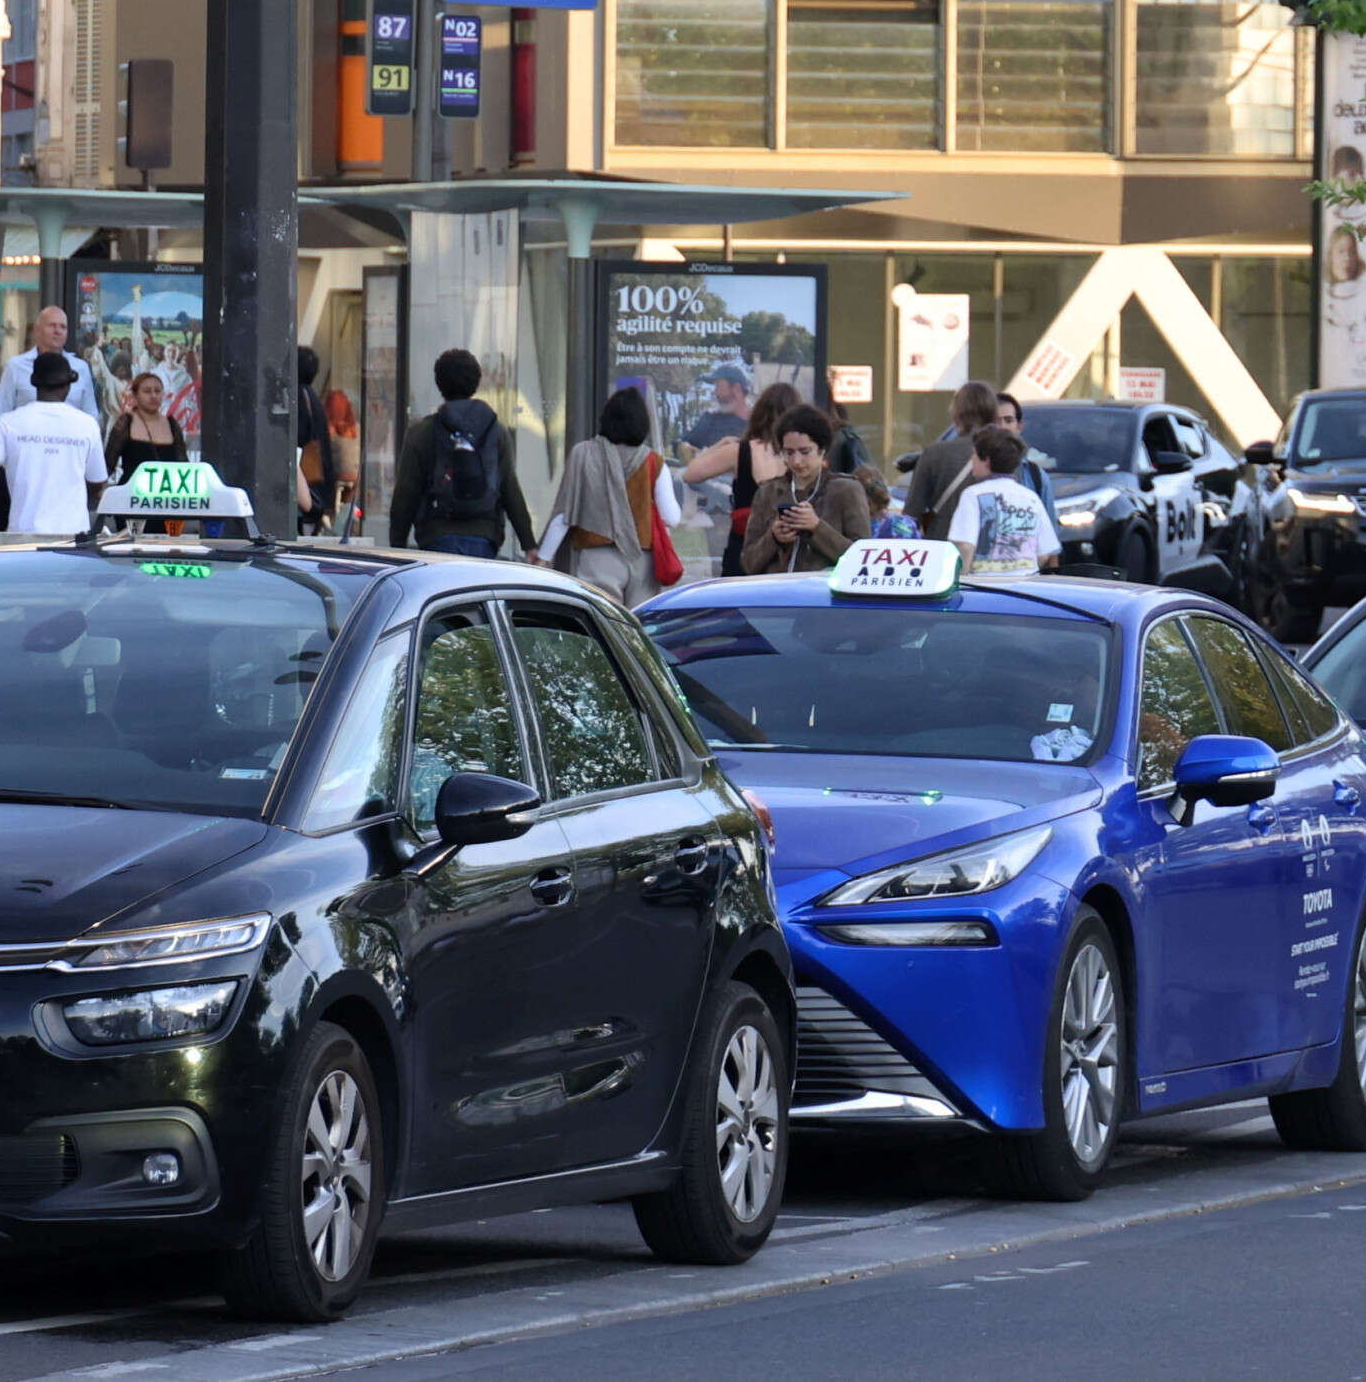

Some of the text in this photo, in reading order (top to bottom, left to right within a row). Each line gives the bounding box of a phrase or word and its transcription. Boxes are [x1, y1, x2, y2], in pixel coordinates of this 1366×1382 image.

[378, 16, 406, 38] 87
[379, 67, 402, 88] 91
[617, 285, 704, 315] 100%
[616, 315, 742, 337] agilité requise
[636, 342, 644, 353] à
[644, 345, 661, 353] son
[662, 345, 696, 356] compte
[710, 344, 742, 356] devrait
[616, 354, 646, 366] jamais
[648, 355, 666, 364] être
[17, 435, 85, 447] HEAD DESIGNER
[144, 468, 202, 494] TAXI
[130, 496, 211, 510] PARISIEN
[1166, 498, 1196, 543] Bolt
[859, 548, 929, 566] TAXI
[851, 577, 924, 587] PARISIEN
[1303, 888, 1333, 915] TOYOTA
